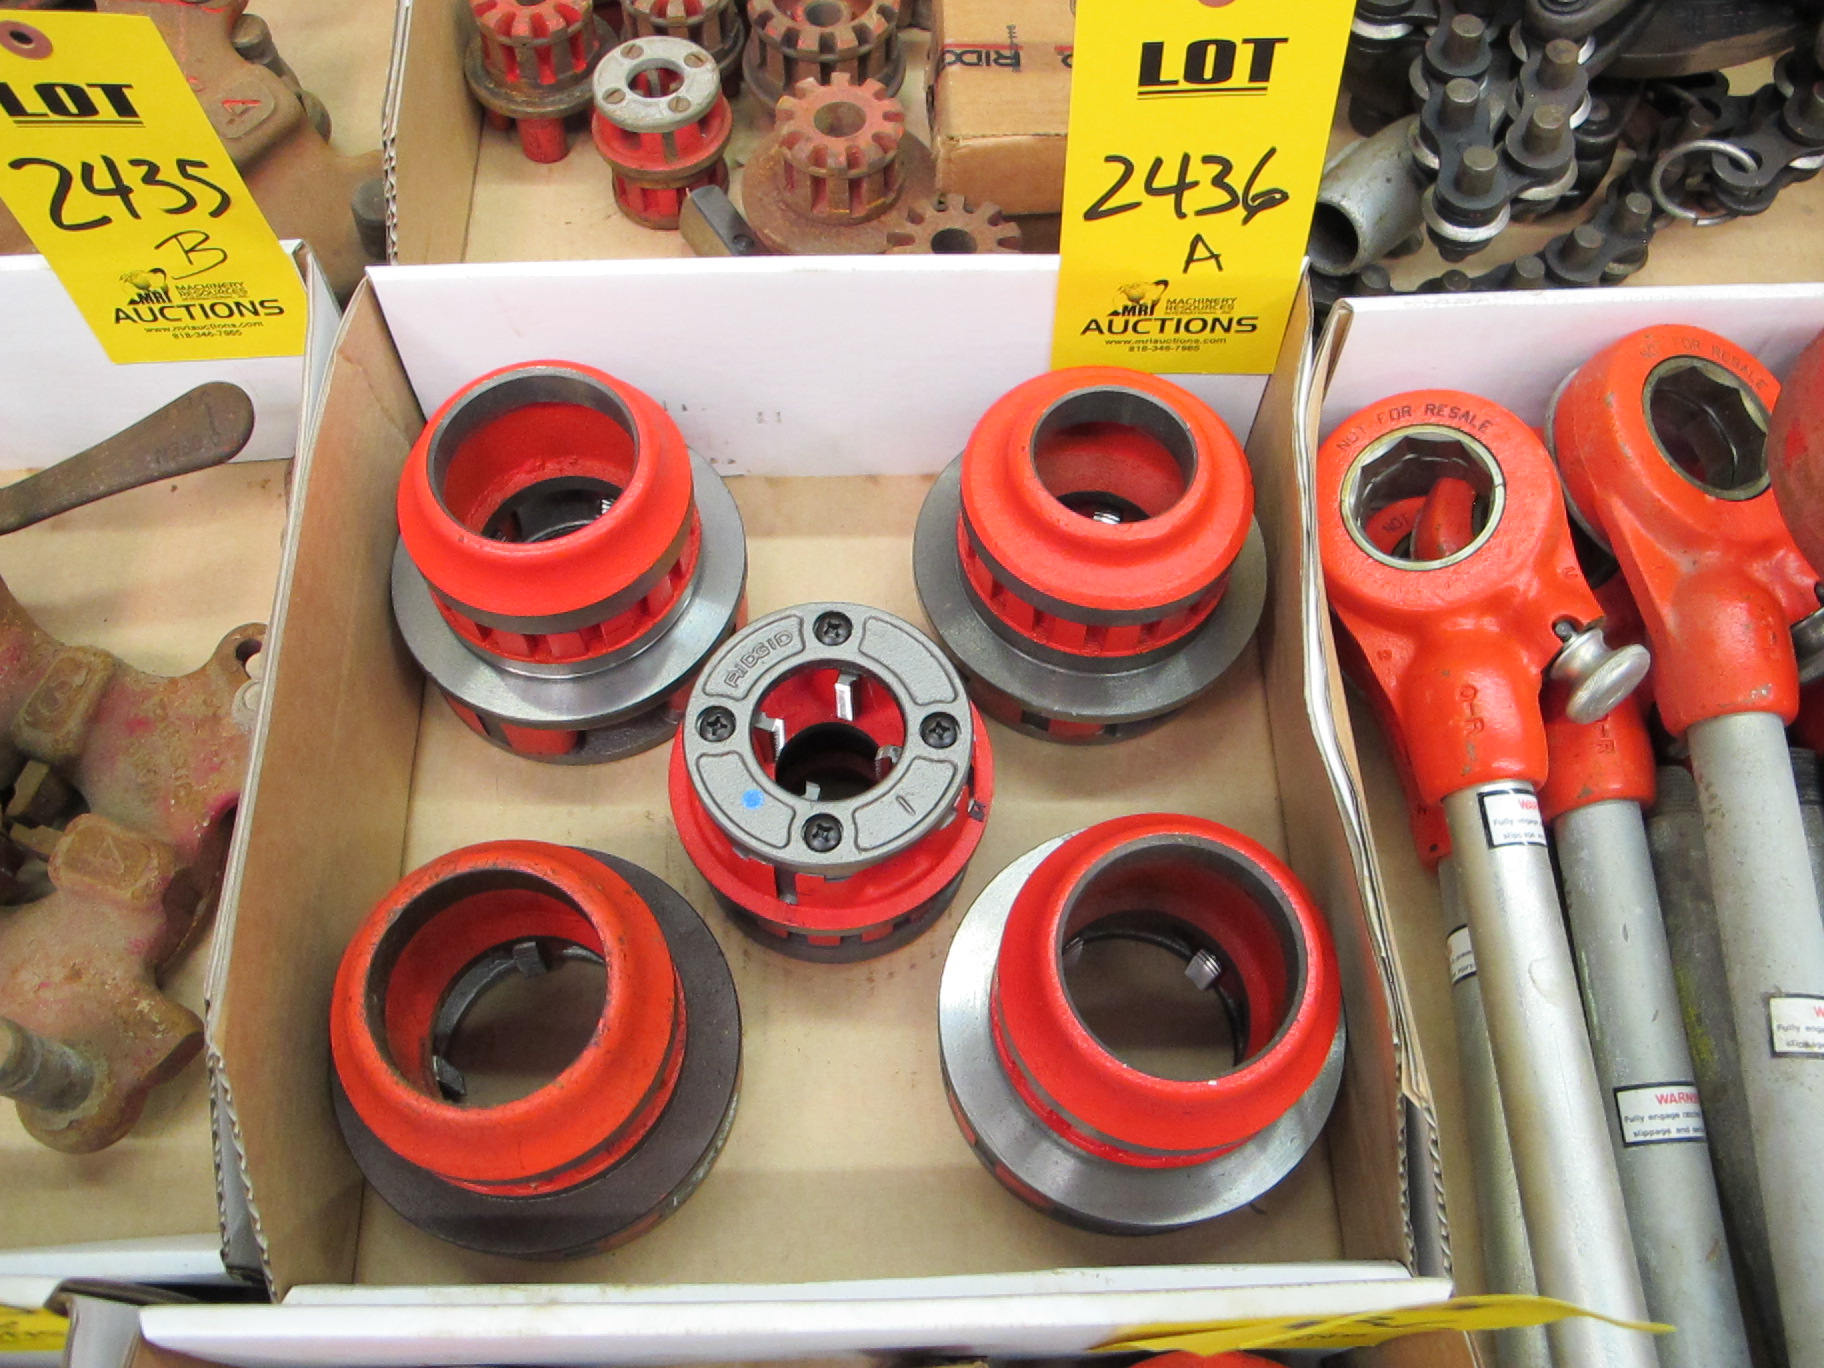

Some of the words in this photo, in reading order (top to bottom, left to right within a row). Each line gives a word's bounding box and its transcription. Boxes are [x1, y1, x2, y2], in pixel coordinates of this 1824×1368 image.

[1138, 37, 1289, 87] LOT
[0, 81, 140, 118] LOT
[8, 154, 232, 232] 2435
[1083, 146, 1290, 226] 2436
[153, 229, 228, 280] B
[1182, 233, 1223, 274] A
[114, 299, 285, 325] AUCTIONS
[1121, 303, 1157, 317] MRI
[1166, 297, 1237, 306] MACHINERY
[1079, 316, 1259, 336] AUCTIONS
[1104, 337, 1227, 346] www.mriauctions.com
[1376, 406, 1412, 424] FOR
[1424, 403, 1493, 432] RESALE
[724, 630, 793, 688] RIDGID
